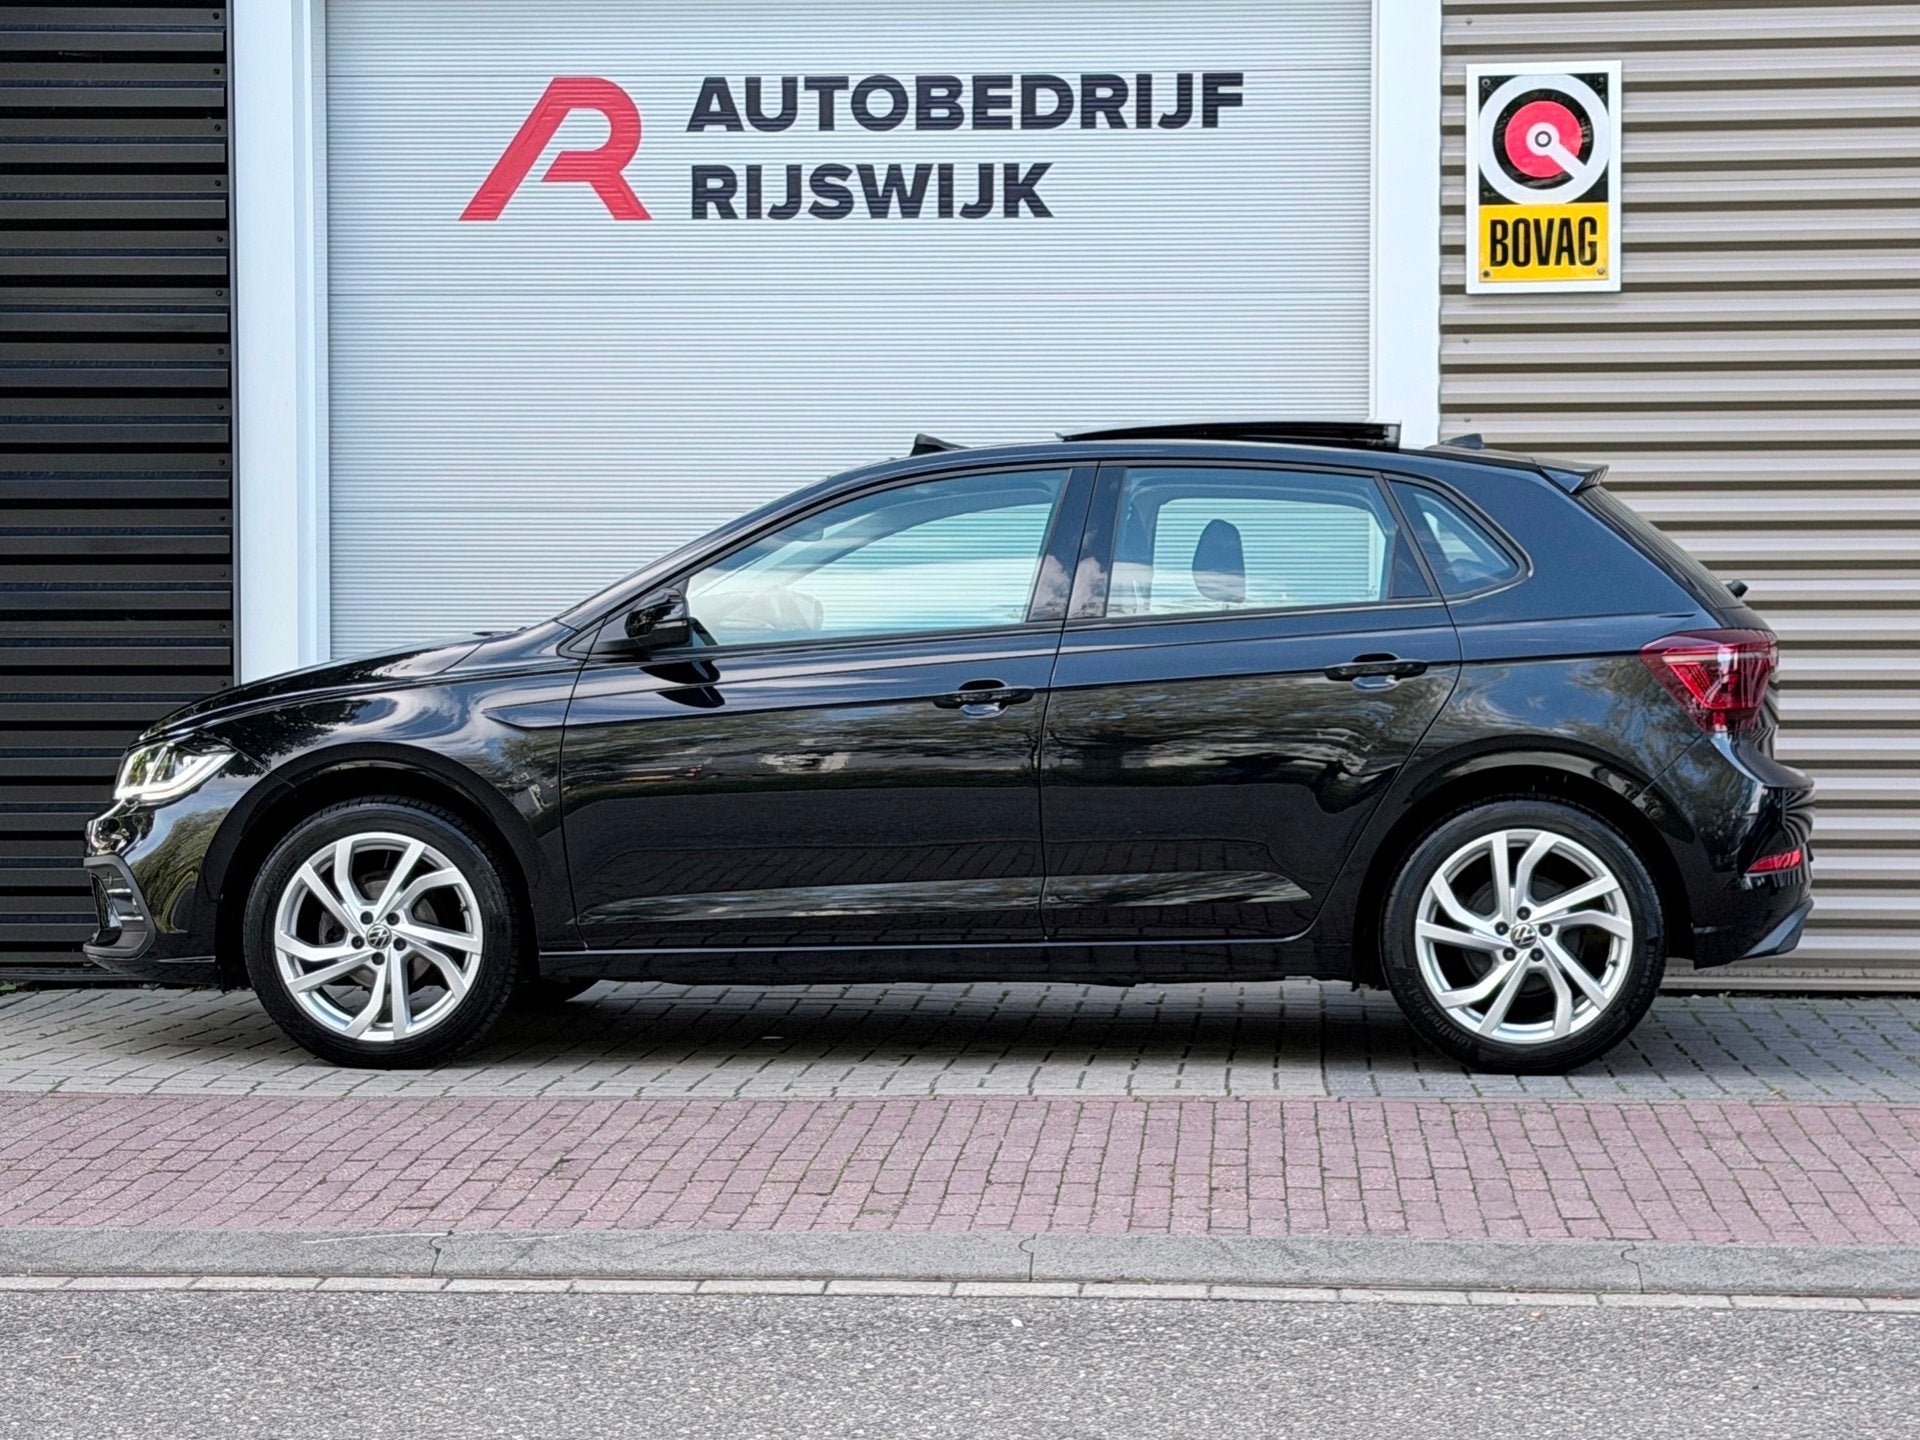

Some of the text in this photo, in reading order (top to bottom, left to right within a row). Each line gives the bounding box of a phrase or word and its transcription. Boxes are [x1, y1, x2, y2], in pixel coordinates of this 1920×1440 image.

[686, 73, 1243, 132] AUTOBEDRIJF
[692, 162, 1053, 220] RIJSWIJK
[1489, 216, 1598, 268] BOVAG
